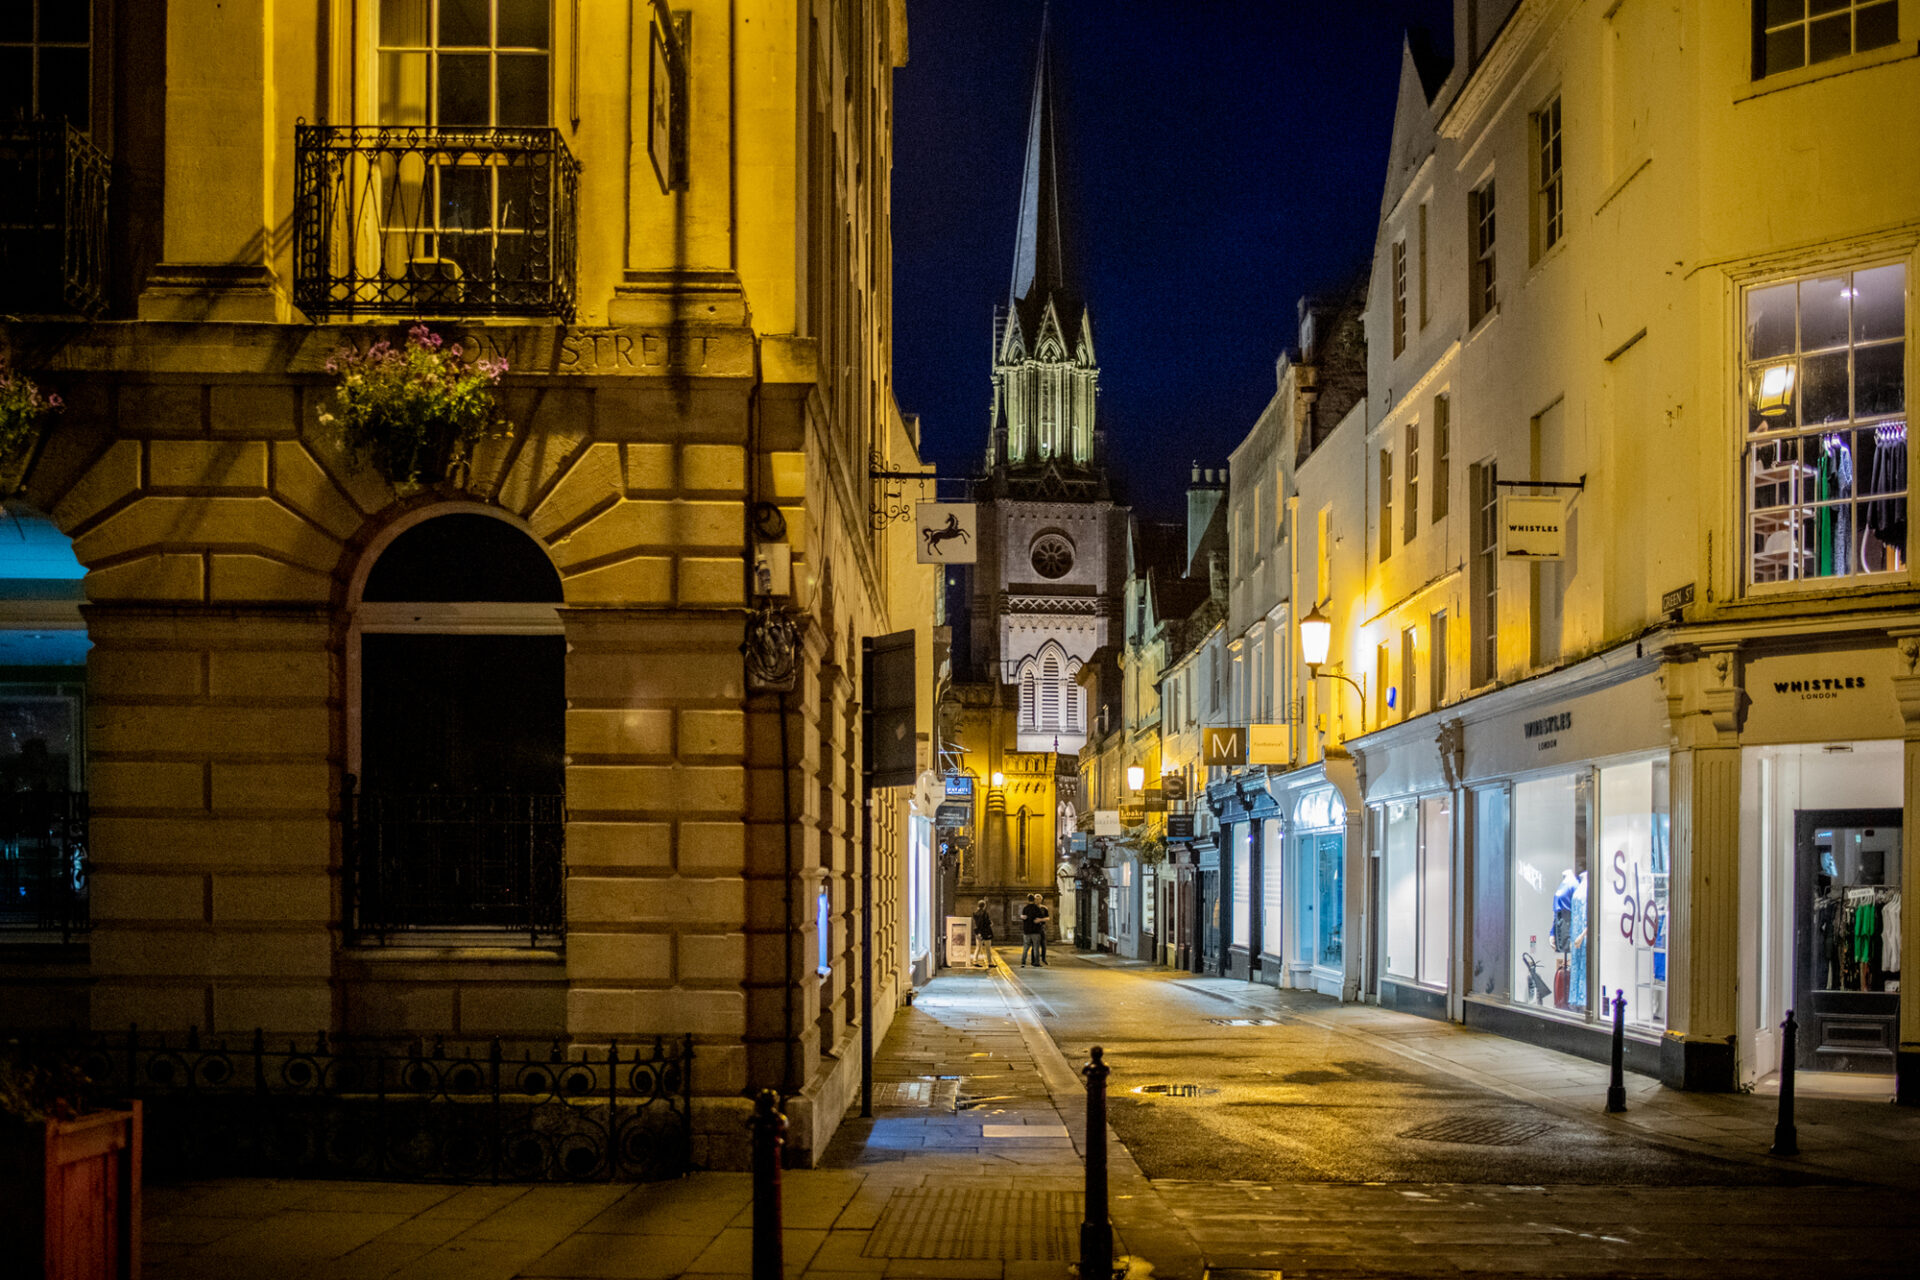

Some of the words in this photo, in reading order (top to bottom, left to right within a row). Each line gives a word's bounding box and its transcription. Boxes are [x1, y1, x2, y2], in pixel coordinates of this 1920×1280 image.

[559, 333, 721, 369] STREET
[1509, 525, 1559, 533] WHISTLES
[1773, 676, 1866, 694] WHISTLES
[1800, 692, 1838, 700] LONDON
[1524, 711, 1572, 739] WHISTLES
[1212, 733, 1237, 758] M
[1537, 739, 1558, 751] LONDON
[1120, 809, 1144, 817] Loake
